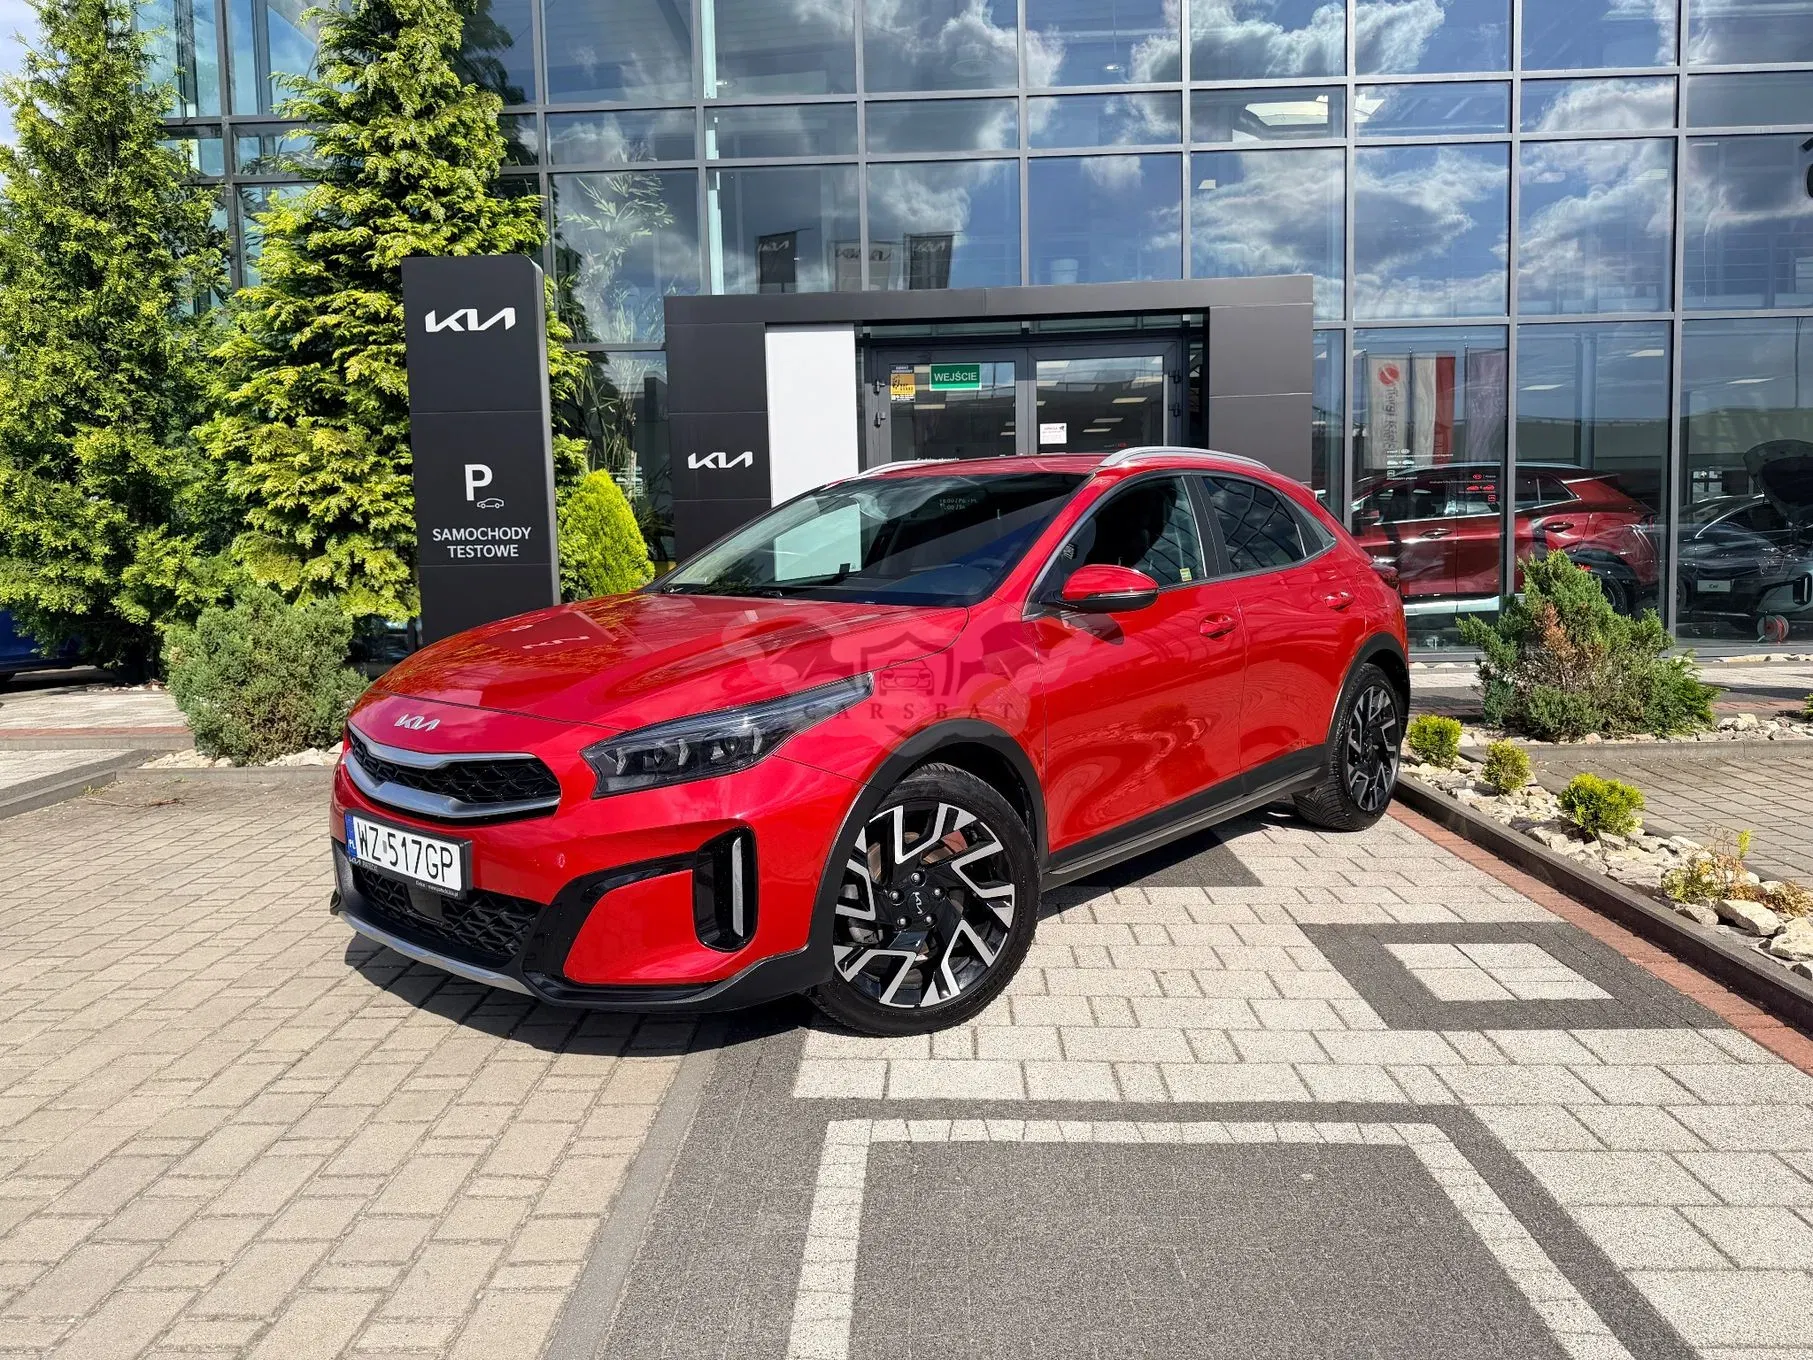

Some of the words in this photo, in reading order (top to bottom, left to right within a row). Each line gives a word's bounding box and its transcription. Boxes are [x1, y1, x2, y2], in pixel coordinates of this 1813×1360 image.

[424, 306, 516, 333] KIA
[934, 371, 978, 382] WEJŚCIE
[687, 451, 753, 469] KIA
[464, 464, 493, 501] P
[432, 526, 532, 541] SAMOCHODY
[447, 544, 520, 558] TESTOWE
[394, 713, 441, 732] KIA
